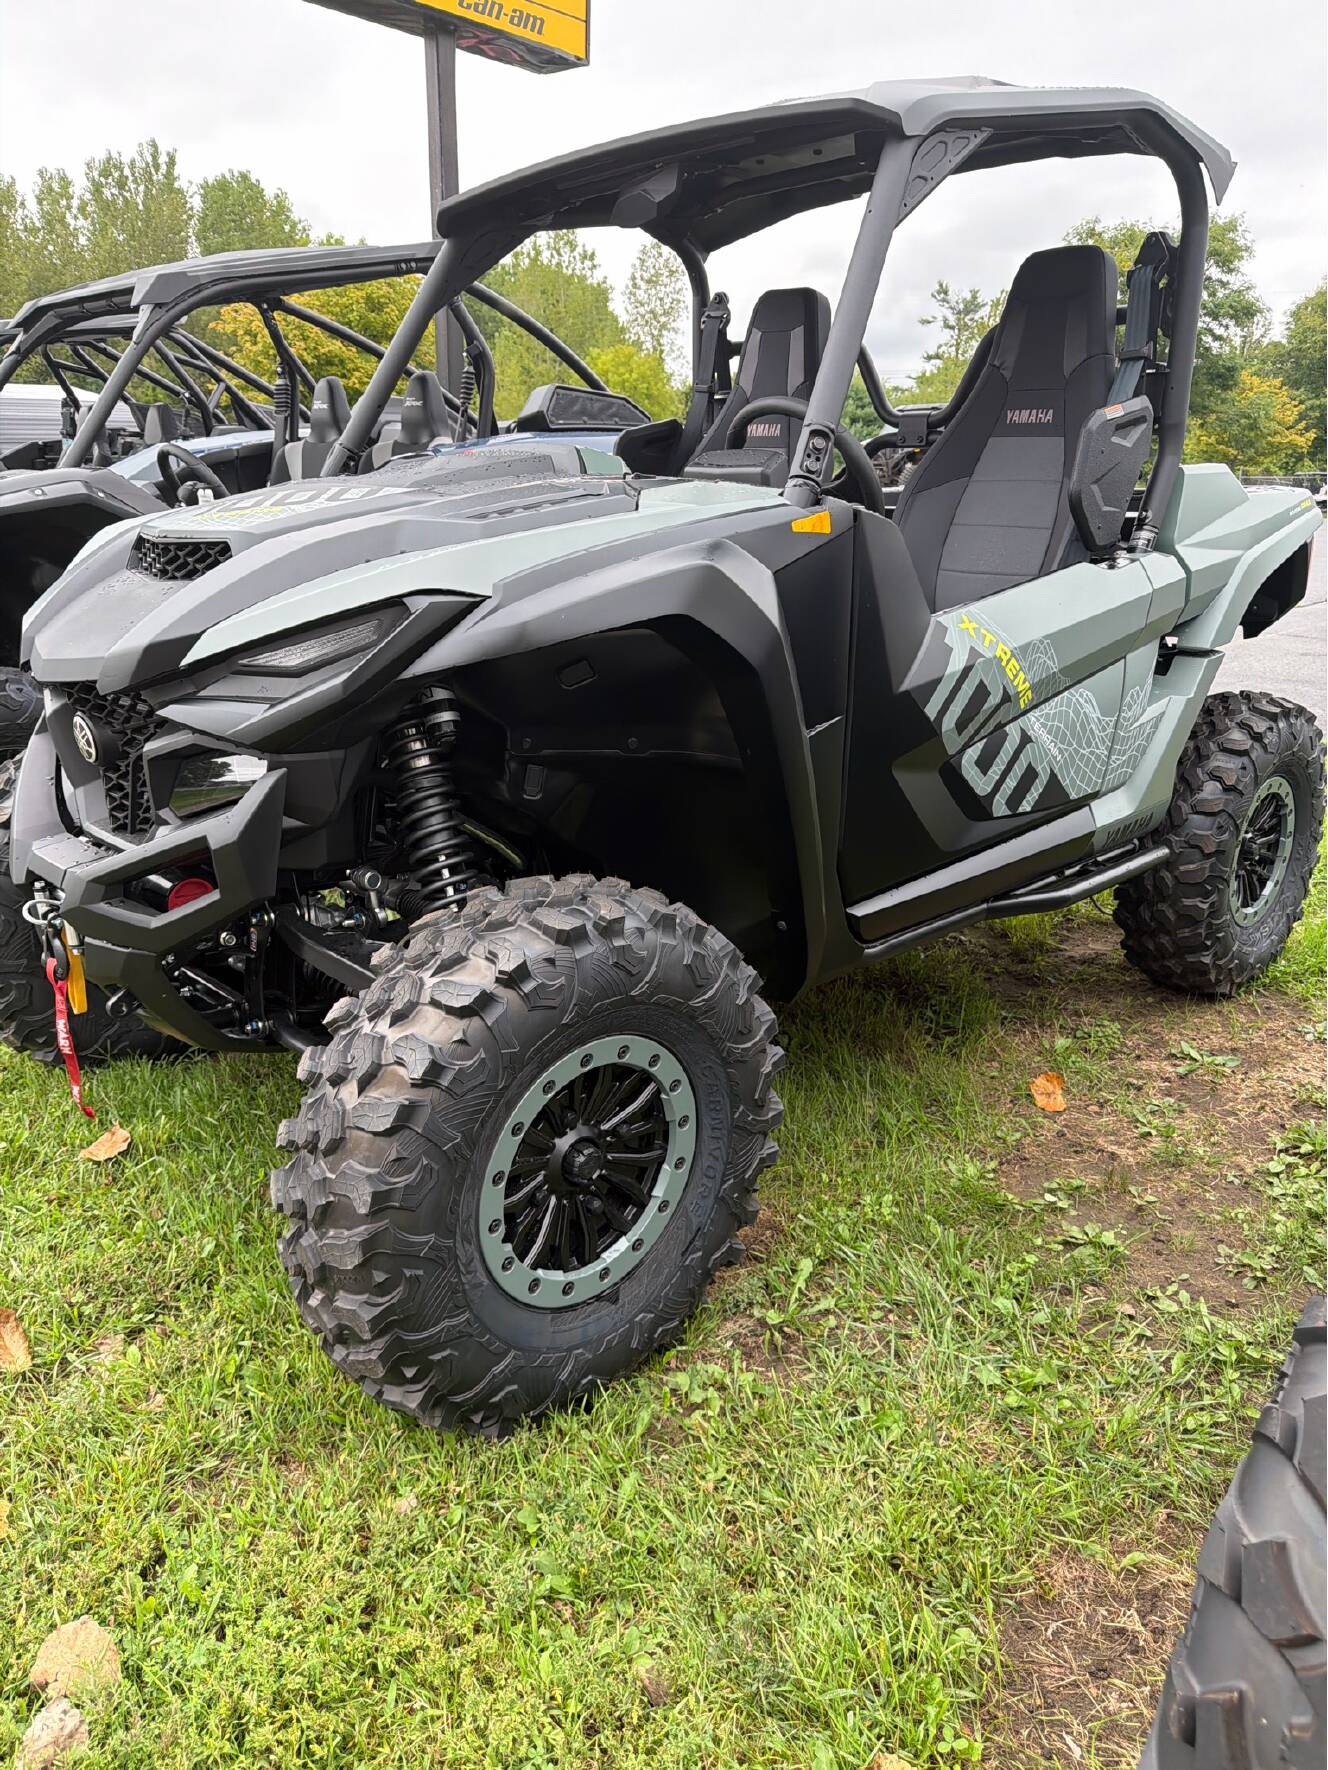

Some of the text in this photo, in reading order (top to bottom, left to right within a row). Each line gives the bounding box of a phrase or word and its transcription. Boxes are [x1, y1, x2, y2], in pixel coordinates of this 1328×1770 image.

[747, 423, 781, 437] YAMAHA
[1006, 409, 1054, 424] YAMAHA
[958, 614, 1034, 709] XTREME
[924, 616, 1051, 818] 1000
[1030, 716, 1062, 761] TERRAIN
[56, 1019, 72, 1055] WARN
